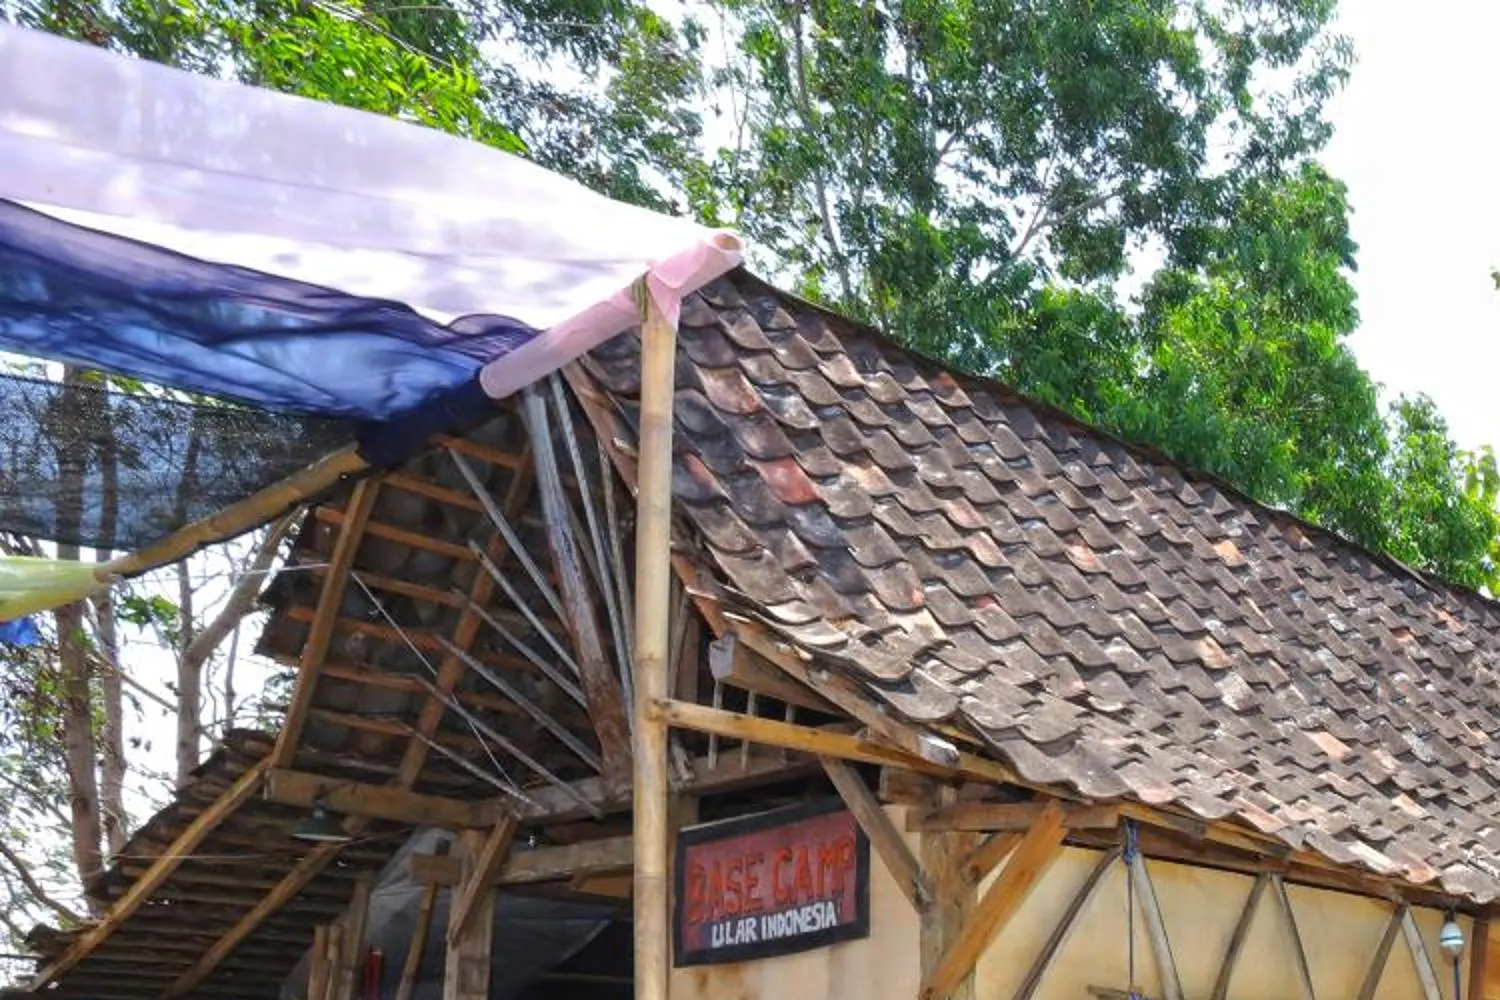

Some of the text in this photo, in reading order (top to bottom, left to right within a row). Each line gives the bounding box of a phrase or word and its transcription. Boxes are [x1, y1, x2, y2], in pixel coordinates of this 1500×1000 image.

[771, 835, 855, 906] CAMP
[711, 901, 838, 948] ULAR INDONESIA
